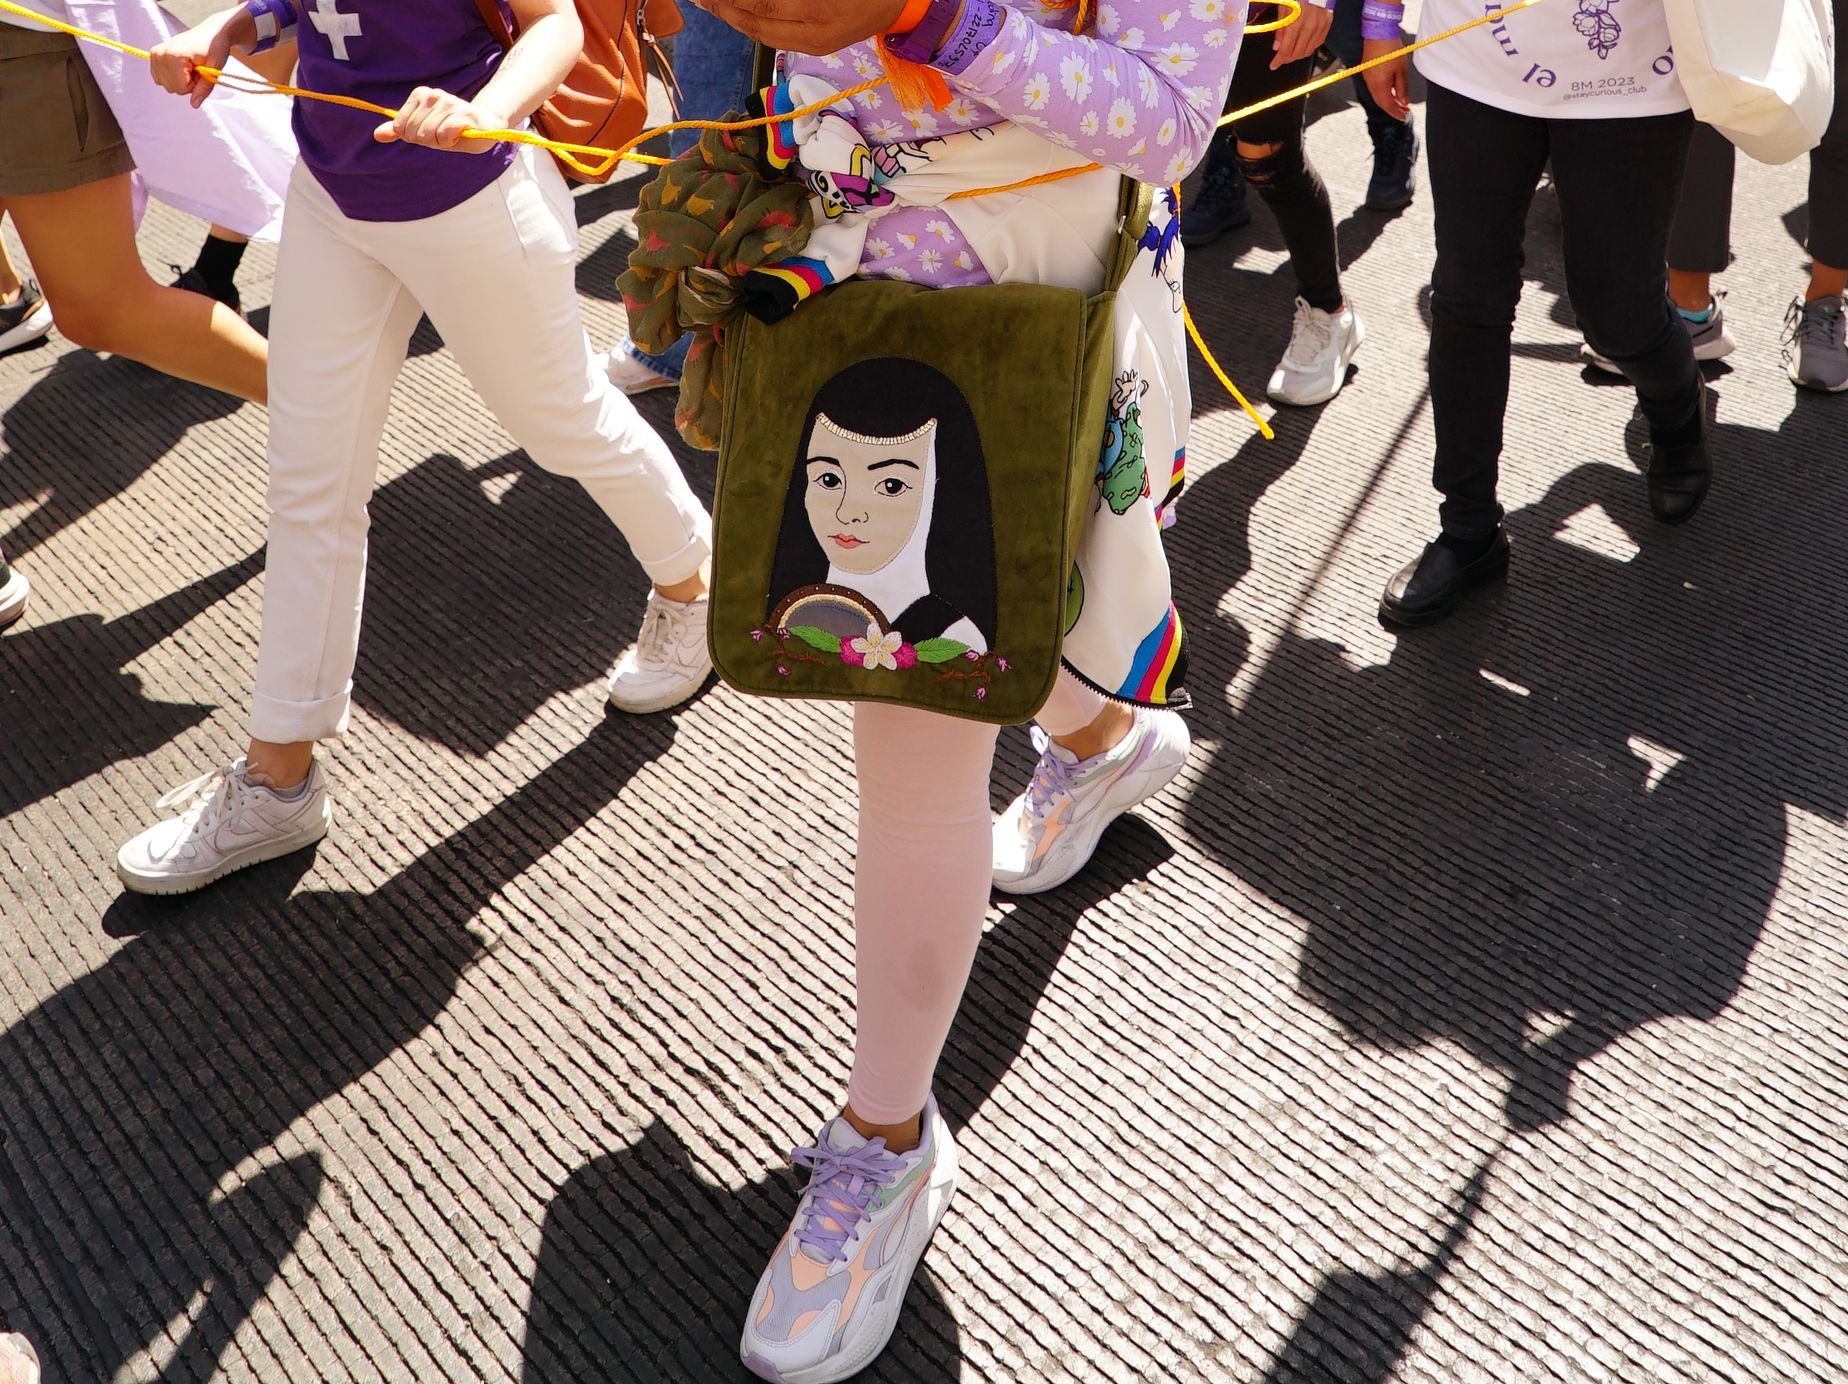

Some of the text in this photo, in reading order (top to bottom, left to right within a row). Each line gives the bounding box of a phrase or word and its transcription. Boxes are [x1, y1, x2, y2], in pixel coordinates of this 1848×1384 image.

[1522, 63, 1557, 88] el
[1570, 76, 1635, 92] 8M 2023
[1563, 85, 1648, 101] @staycurious_club
